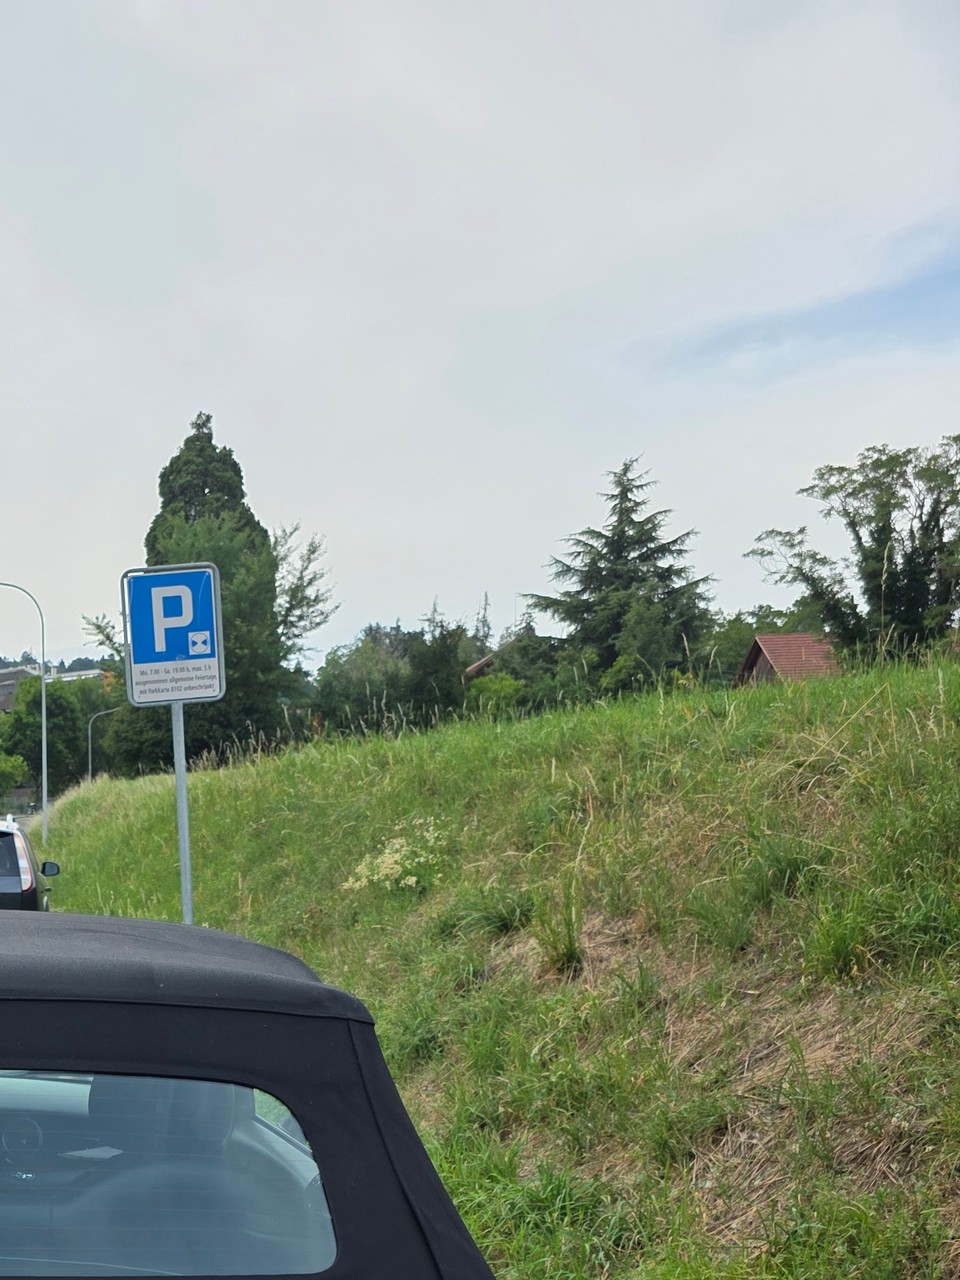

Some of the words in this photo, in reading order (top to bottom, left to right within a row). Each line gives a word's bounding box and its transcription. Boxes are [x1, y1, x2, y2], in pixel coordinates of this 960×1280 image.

[151, 585, 193, 653] P
[135, 678, 168, 687] ausgenommen
[169, 676, 194, 685] allgemeine
[148, 686, 170, 694] Parkkarte
[171, 685, 182, 693] 8102
